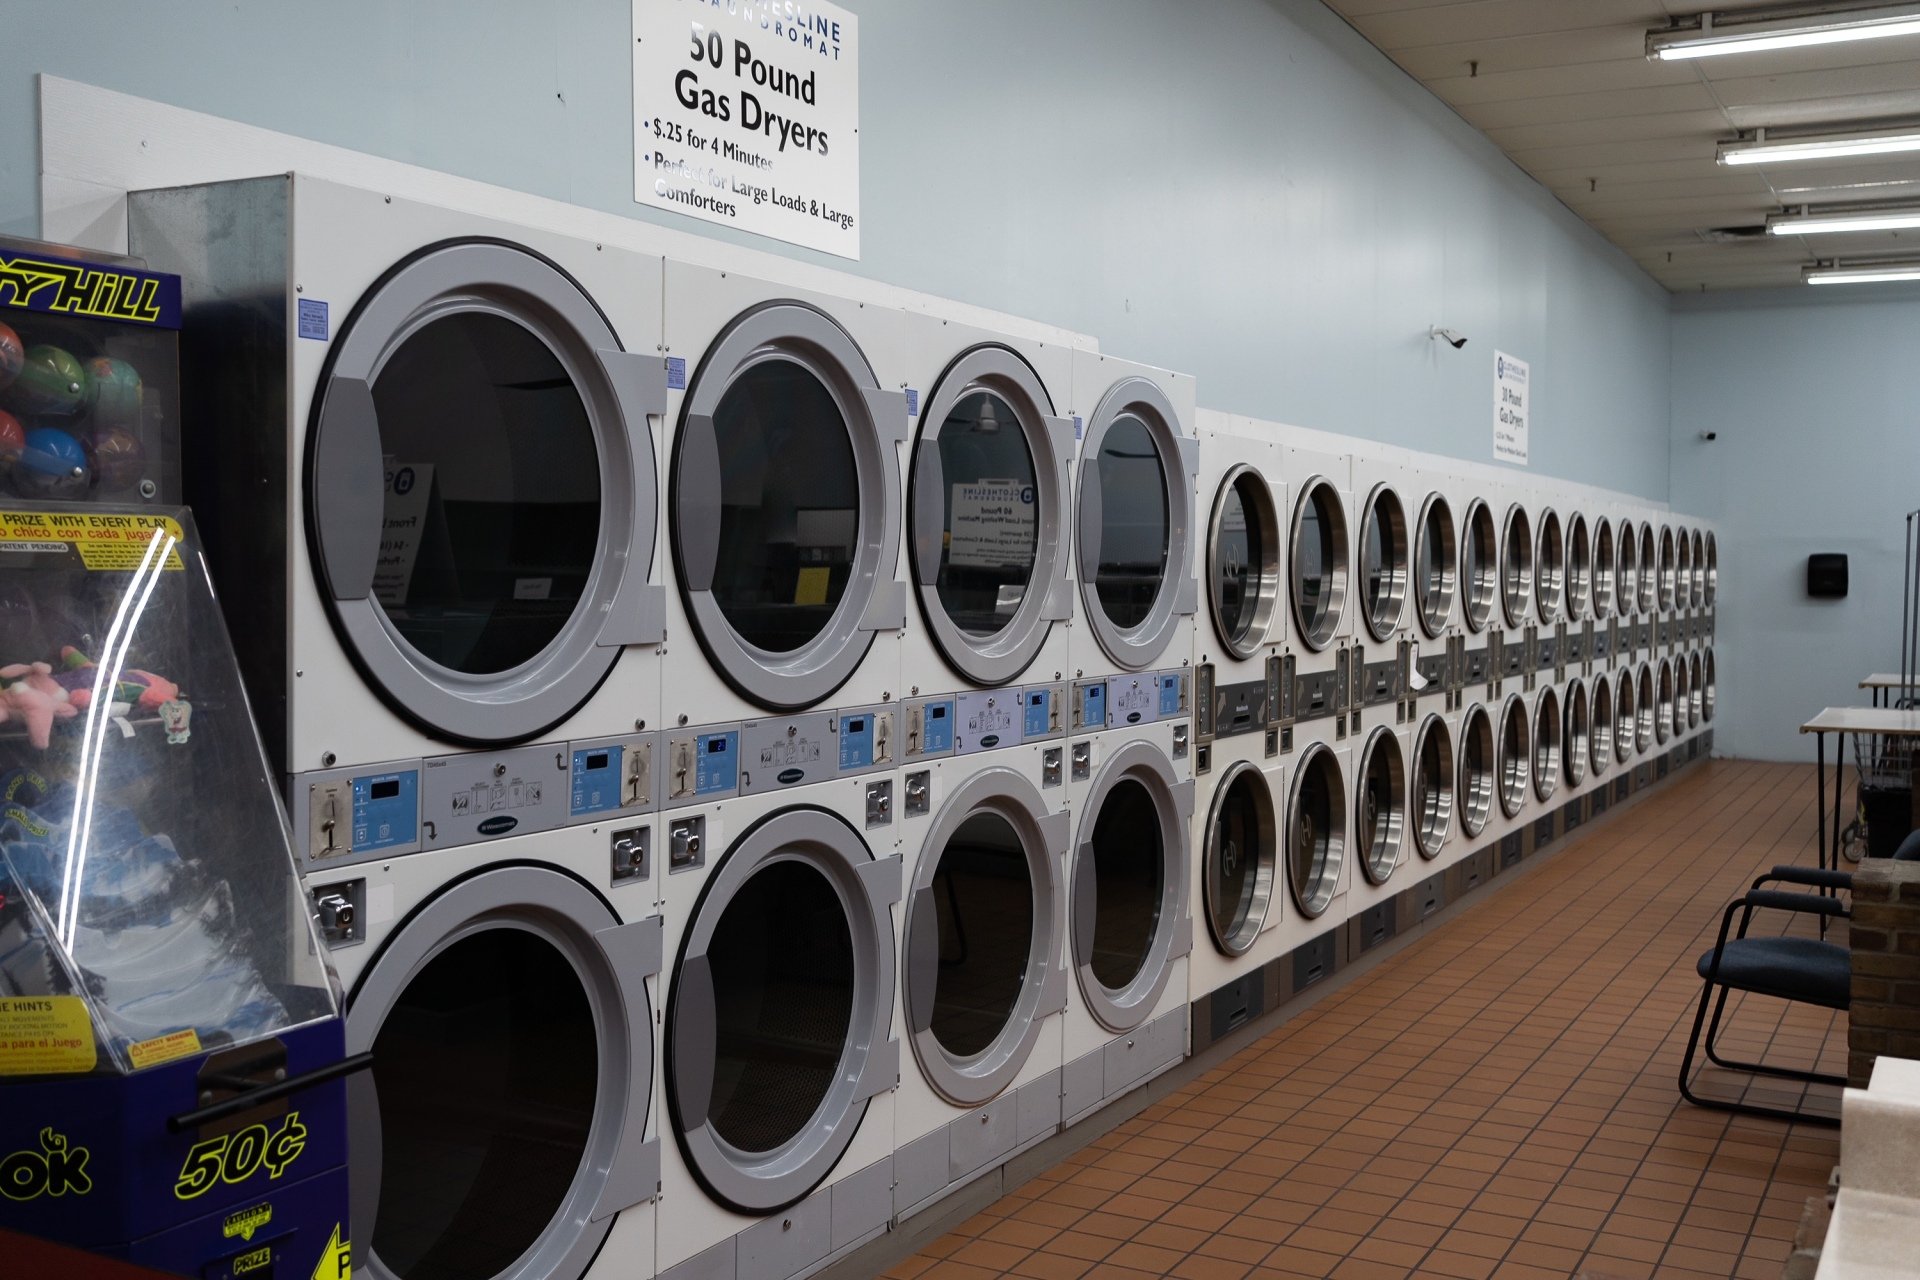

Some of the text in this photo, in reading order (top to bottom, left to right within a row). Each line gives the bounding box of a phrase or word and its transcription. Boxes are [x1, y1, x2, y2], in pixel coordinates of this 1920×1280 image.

[701, 0, 840, 60] AUNDROMAT
[690, 20, 816, 106] 50 Pound
[675, 69, 829, 157] Gas Dryers
[653, 117, 774, 173] $.25 for 4 Minutes
[654, 151, 854, 230] Perfect for Large Loads & Large
[654, 177, 736, 217] Comforters
[3, 514, 168, 528] PRIZE WITH EVERY PLAY
[13, 527, 51, 538] chico
[58, 528, 86, 538] con
[87, 528, 120, 539] cada
[13, 1001, 53, 1012] HINTS
[12, 1040, 36, 1049] para
[39, 1039, 48, 1047] el
[51, 1038, 82, 1049] Juego
[0, 1146, 92, 1200] OK
[174, 1112, 307, 1200] 50¢
[234, 1248, 271, 1275] PRIZE
